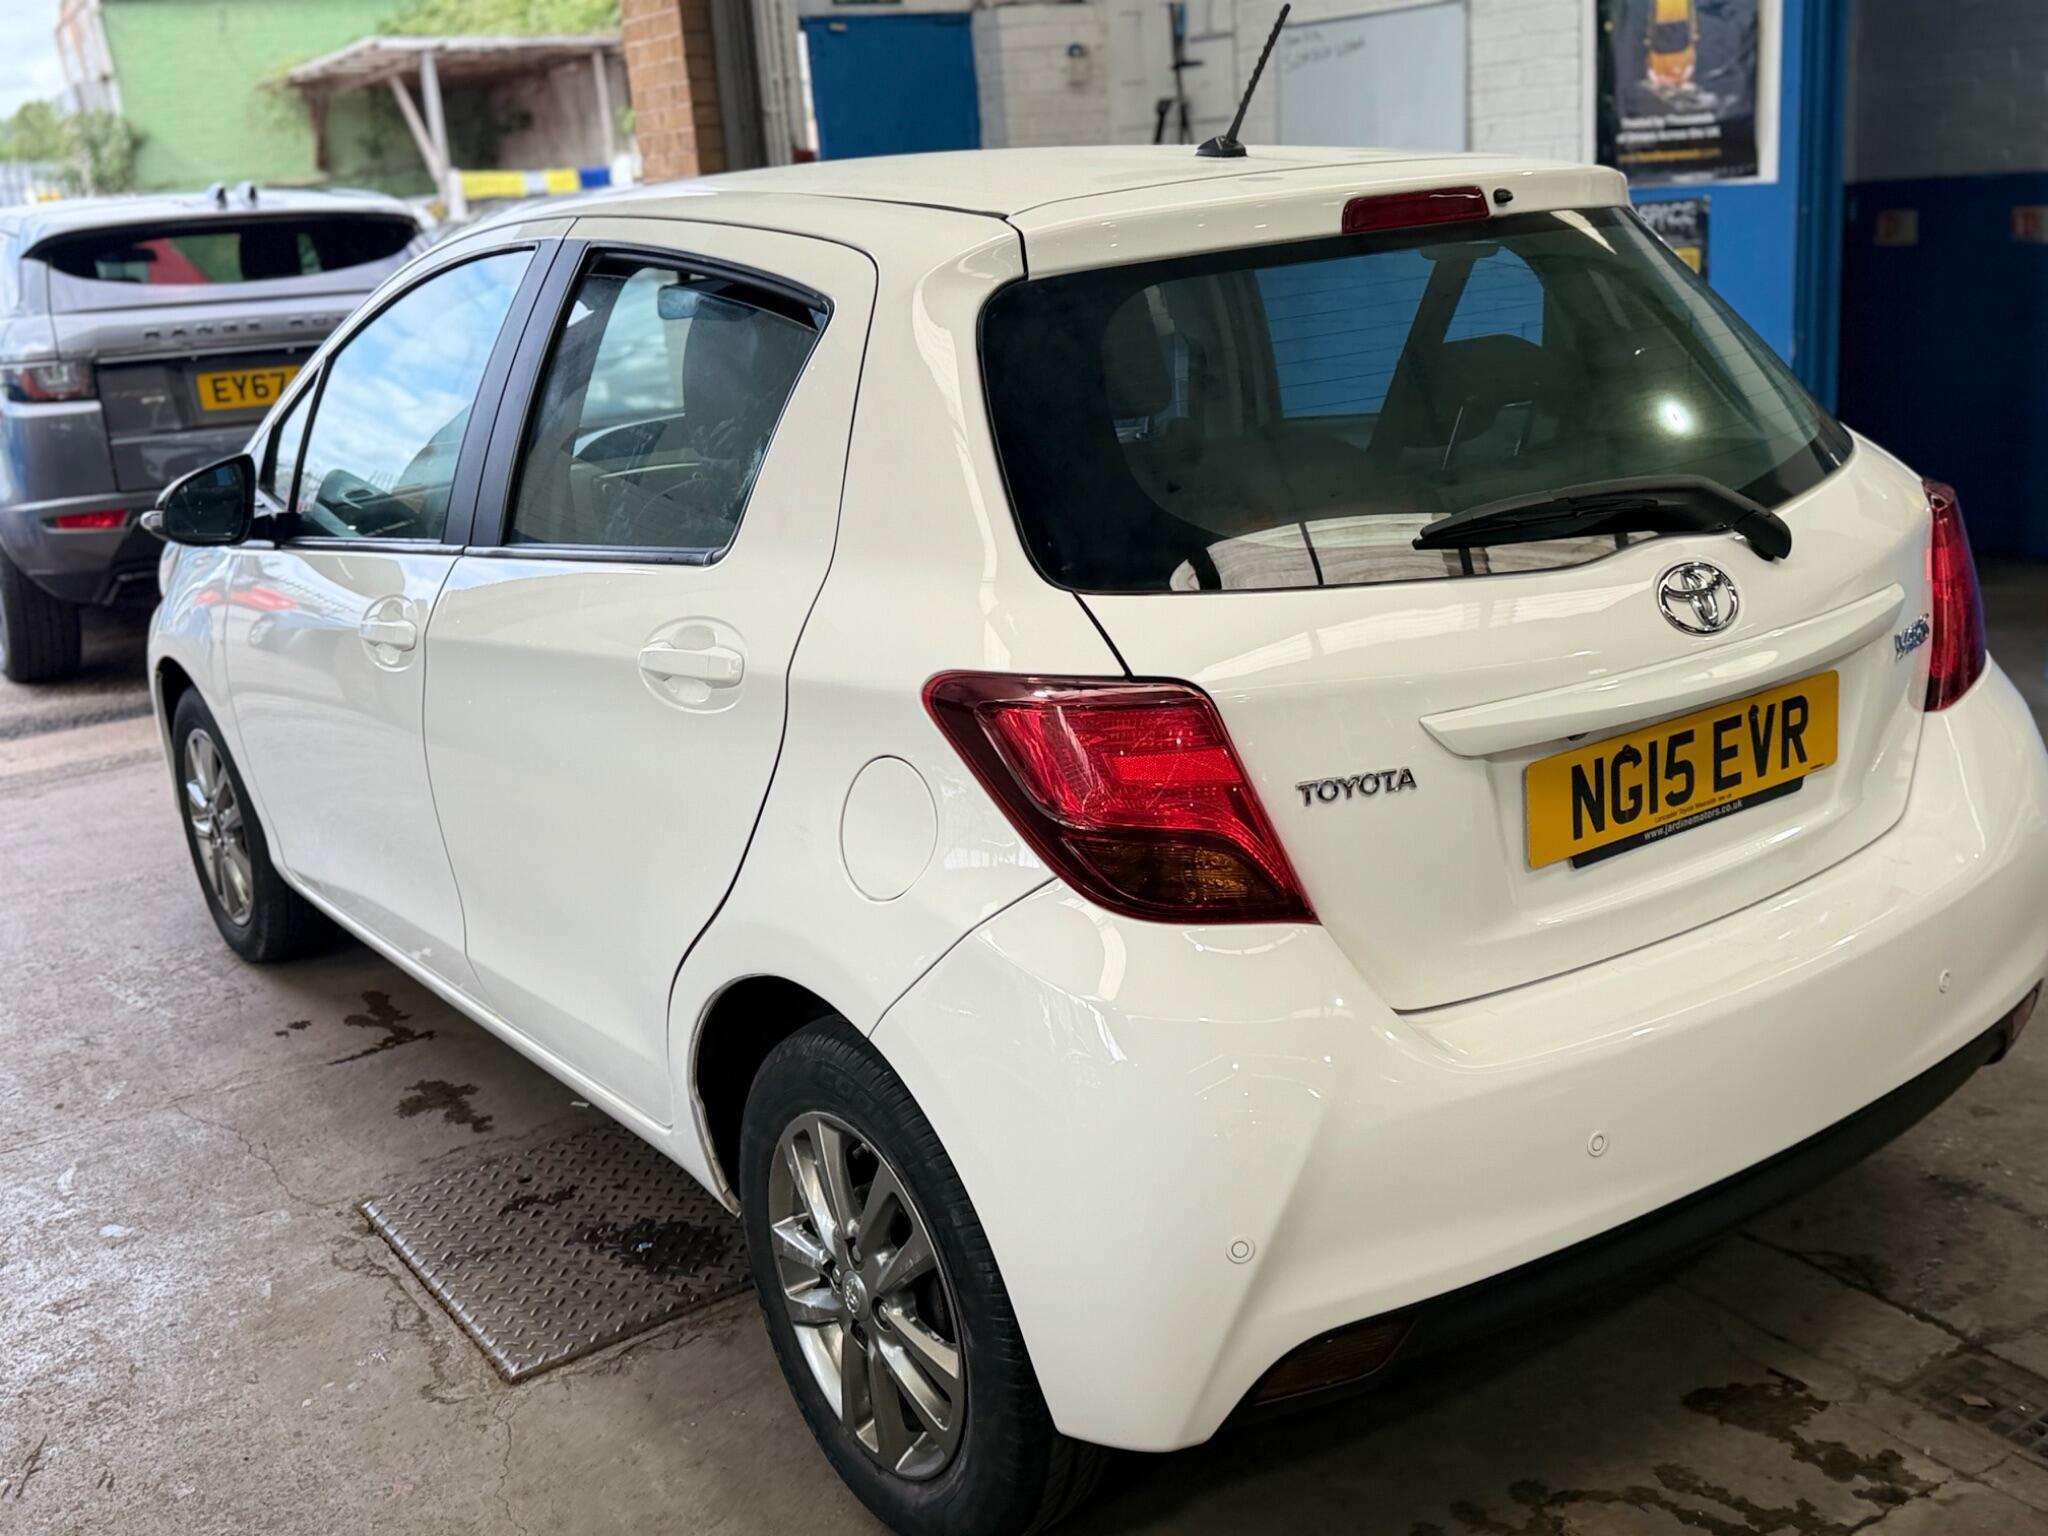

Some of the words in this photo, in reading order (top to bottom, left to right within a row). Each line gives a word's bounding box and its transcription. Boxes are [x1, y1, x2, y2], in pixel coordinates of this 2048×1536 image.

[211, 371, 287, 403] EY67
[1295, 767, 1418, 807] TOYOTA
[1570, 728, 1695, 841] NG15
[1713, 694, 1809, 793] EVR
